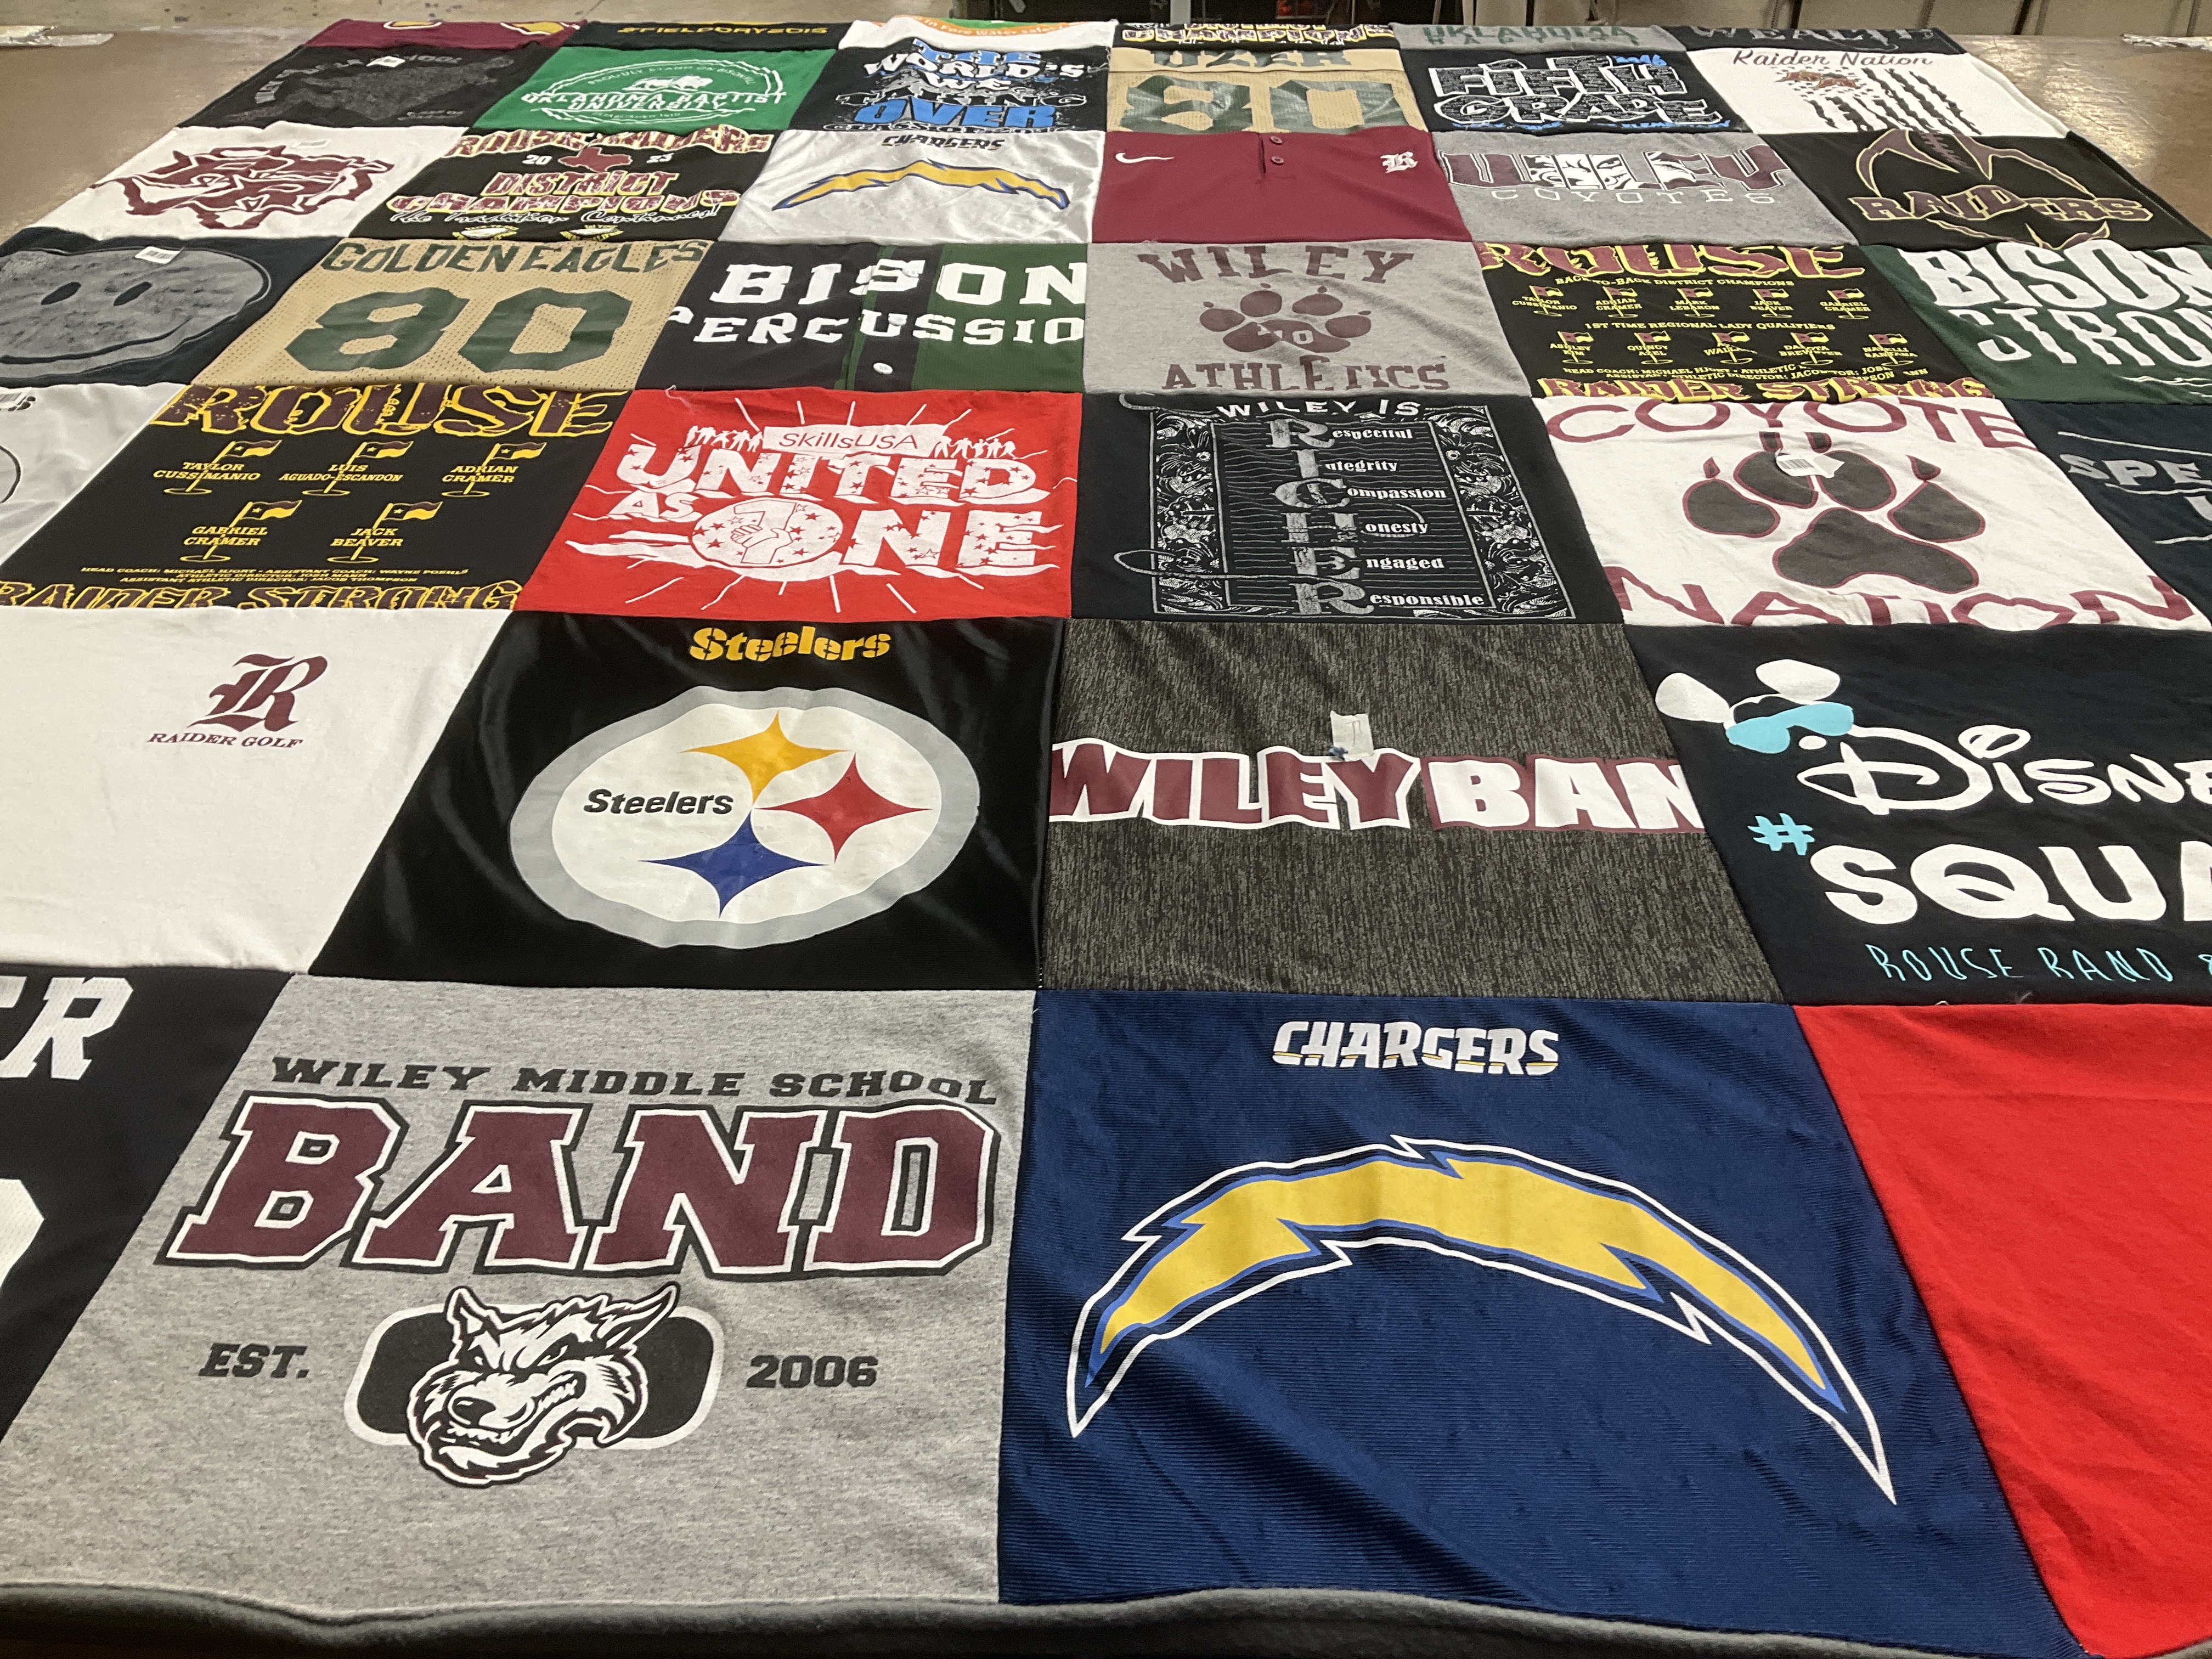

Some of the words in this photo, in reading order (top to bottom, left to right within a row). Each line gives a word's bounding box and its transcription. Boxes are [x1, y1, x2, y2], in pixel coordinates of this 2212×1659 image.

[1733, 49, 1830, 65] Raider
[1840, 52, 1934, 66] Nation
[854, 96, 1054, 128] OVER
[1434, 93, 1723, 124] GRADE
[881, 134, 1005, 150] CHARGERS
[522, 154, 554, 165] 20
[480, 171, 680, 196] DISTRICT
[1491, 187, 1775, 204] COYOTES
[386, 189, 741, 214] CHAMPIONS
[1848, 184, 2154, 222] RAIDERS
[321, 241, 520, 273] GOLDEN
[520, 240, 709, 273] EAGLES
[1137, 245, 1414, 284] WILEY
[1473, 242, 1865, 279] ROUSE
[709, 258, 1087, 306] BISON
[1898, 239, 2212, 311] BISON
[285, 286, 632, 373] 80
[1537, 377, 1752, 403] RAIDER
[151, 382, 625, 437] ROUSE
[1216, 397, 1357, 420] WILEY
[1378, 397, 1422, 417] IS
[1547, 399, 2040, 450] COYOTE
[777, 430, 919, 452] SkillsUSA
[153, 470, 261, 482] CUSSIMANIO
[183, 462, 245, 472] TAYLOR
[328, 464, 368, 473] LUIS
[442, 474, 515, 484] CRAMER
[450, 465, 519, 475] ADRIAN
[616, 442, 1051, 506] UNITED
[608, 490, 703, 522] AS
[183, 537, 261, 547] CRAMER
[191, 526, 268, 537] GABRIEL
[330, 537, 403, 548] BEAVER
[350, 527, 397, 537] JACK
[0, 580, 232, 610] RAIDER
[238, 579, 525, 611] STRONG
[689, 625, 891, 662] Steelers
[187, 653, 329, 733] R
[147, 732, 237, 746] RAIDER
[240, 736, 304, 749] GOLF
[1048, 738, 1421, 831] WILEY
[583, 788, 735, 816] Steelers
[1864, 943, 2025, 983] ROUSE
[1272, 1020, 1560, 1076] CHARGERS
[272, 1056, 493, 1092] WILEY
[511, 1065, 758, 1099] MIDDLE
[768, 1069, 1000, 1107] SCHOOL
[155, 1089, 1002, 1282] BAND
[200, 1342, 311, 1381] EST.
[745, 1354, 880, 1391] 2006
